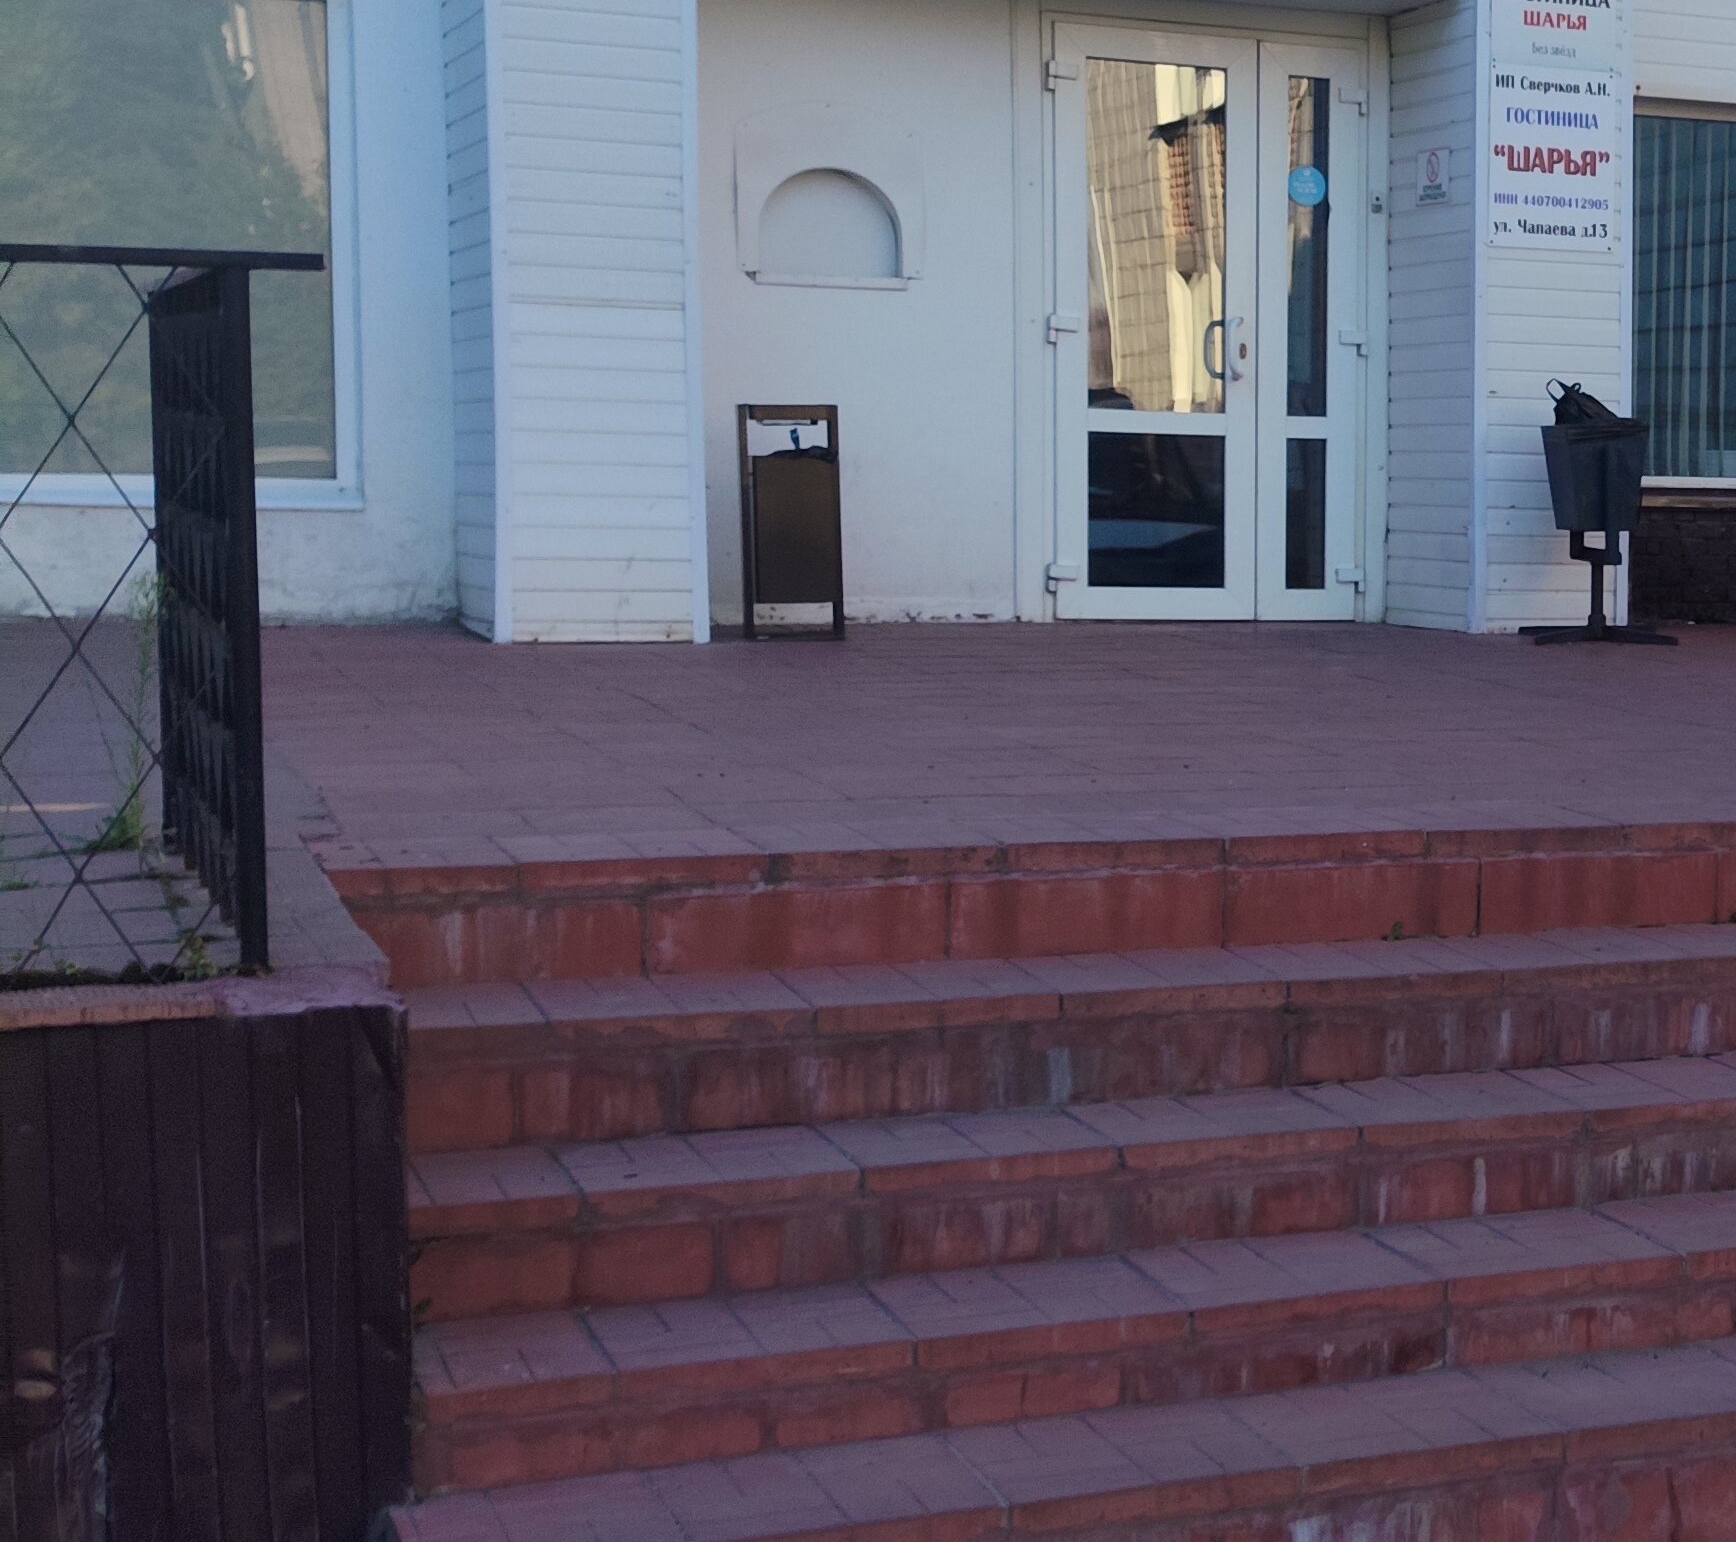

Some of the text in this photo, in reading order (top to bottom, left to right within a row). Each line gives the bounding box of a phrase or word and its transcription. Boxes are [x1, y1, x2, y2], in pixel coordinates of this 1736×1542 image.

[1523, 10, 1587, 31] ШАРЬЯ
[1495, 73, 1515, 89] ИП
[1520, 75, 1581, 94] Сверчков
[1506, 106, 1599, 130] ГОСТИНИЦА
[1494, 192, 1609, 210] ИНН 440700412905
[1493, 221, 1512, 235] ул.
[1517, 218, 1577, 237] Чапаева
